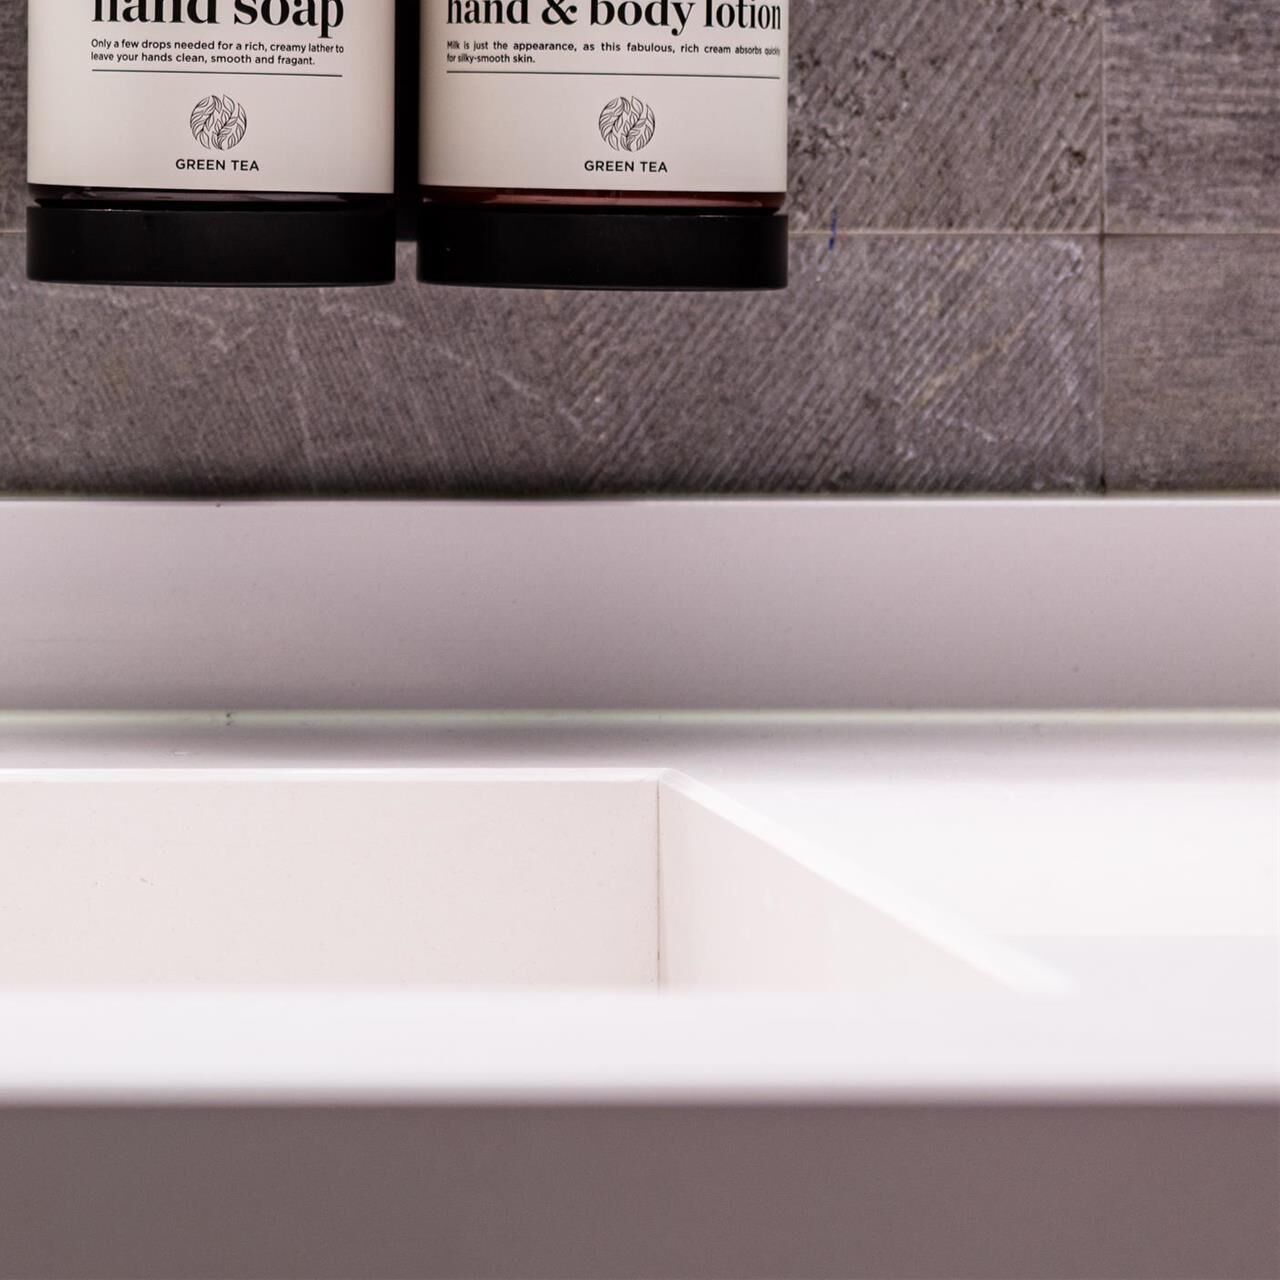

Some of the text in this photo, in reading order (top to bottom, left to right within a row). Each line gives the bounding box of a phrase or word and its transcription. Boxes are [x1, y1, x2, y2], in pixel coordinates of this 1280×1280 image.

[91, 38, 112, 49] Only
[121, 39, 139, 48] few
[141, 39, 172, 50] drops
[174, 41, 215, 49] needed
[217, 41, 233, 50] for
[244, 42, 268, 52] rich,
[270, 44, 307, 54] creamy
[308, 43, 334, 53] lather
[335, 45, 345, 53] to
[463, 41, 470, 50] is
[473, 41, 488, 51] just
[493, 41, 508, 50] the
[513, 43, 577, 52] appearance,
[601, 42, 621, 51] this
[627, 42, 675, 53] fabulous,
[680, 44, 699, 53] rich
[704, 45, 731, 53] cream
[735, 45, 762, 55] absorbs
[91, 52, 315, 66] leave your hands clean, smooth and fragant.
[447, 53, 536, 64] for silky-smooth skin.
[175, 158, 259, 171] GREEN TEA
[584, 160, 668, 173] GREEN TEA
